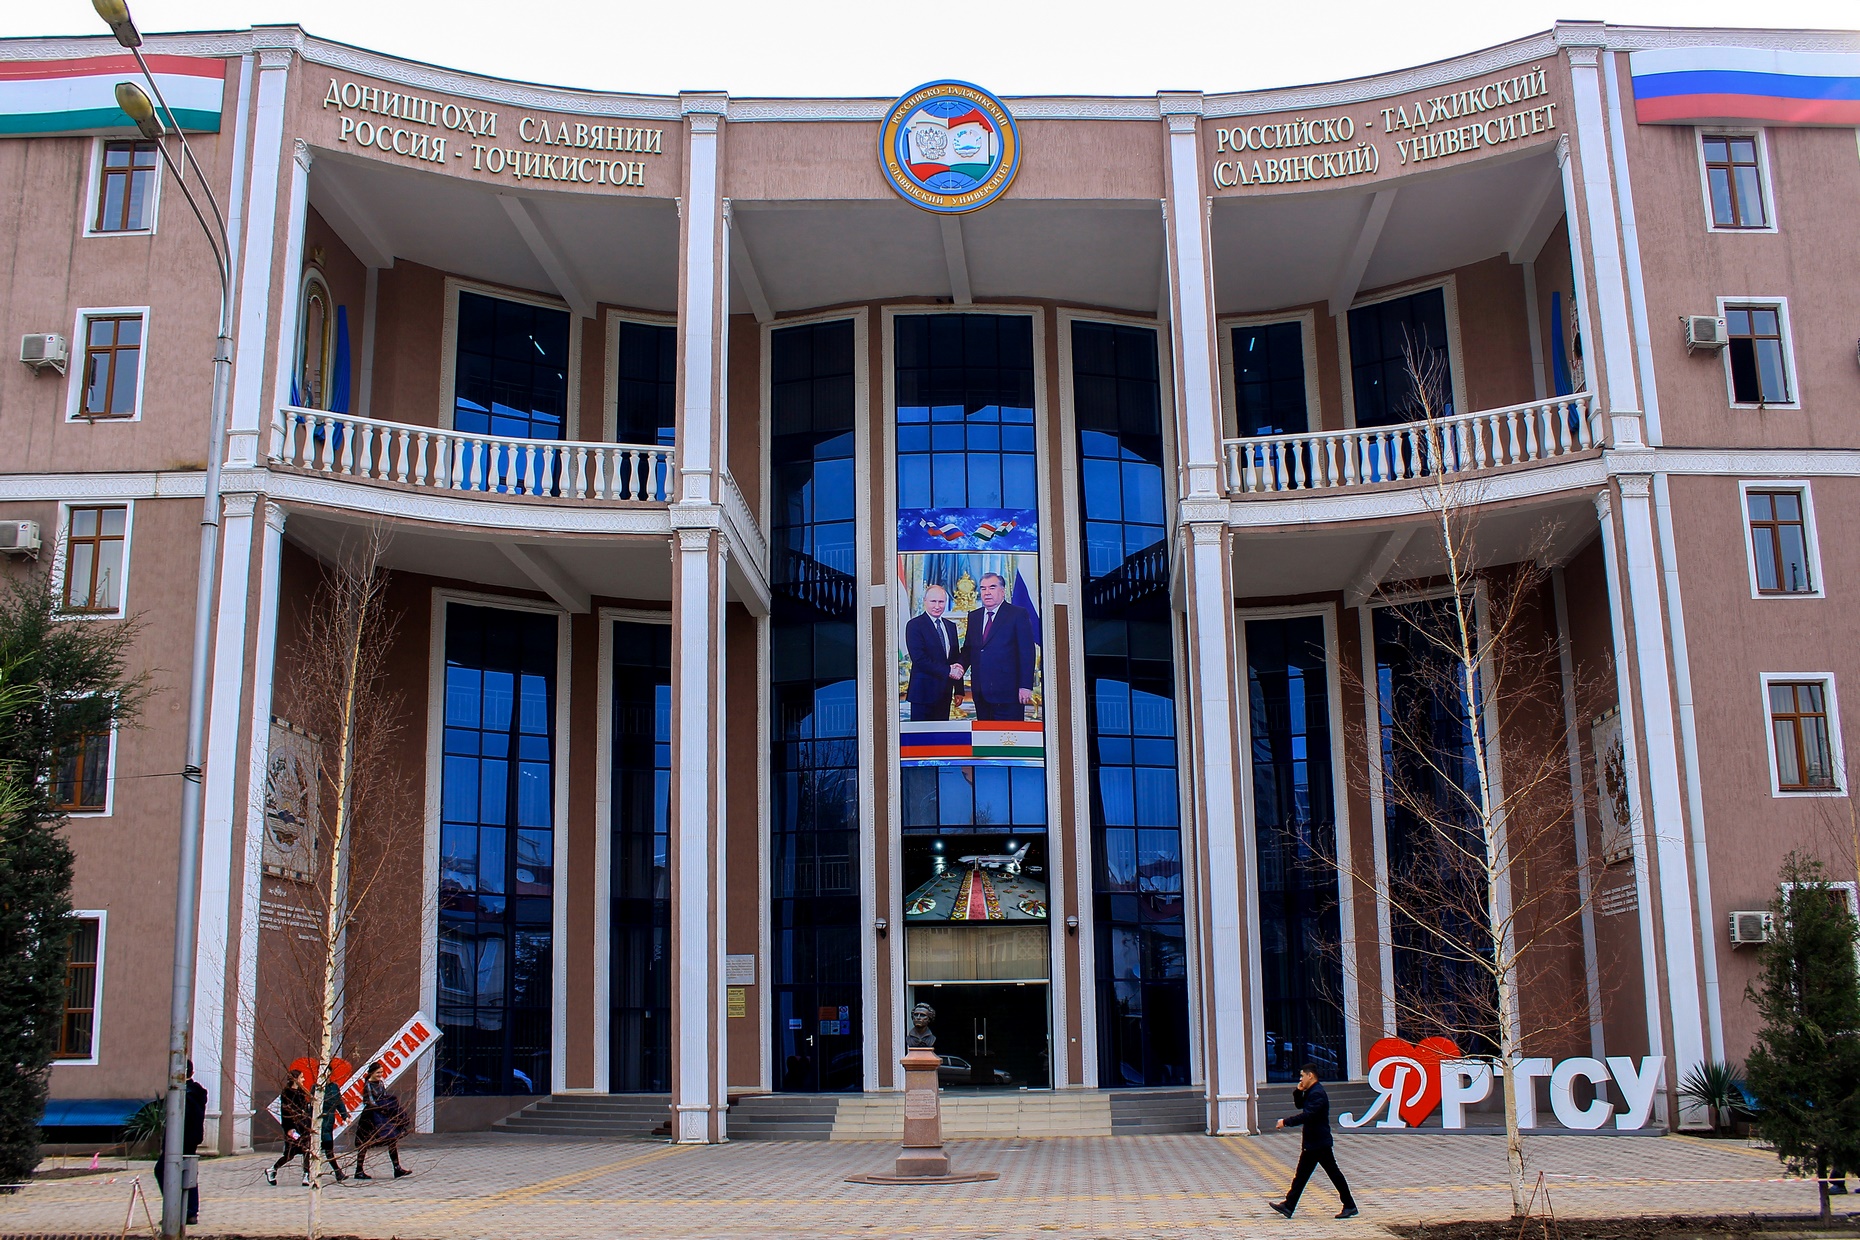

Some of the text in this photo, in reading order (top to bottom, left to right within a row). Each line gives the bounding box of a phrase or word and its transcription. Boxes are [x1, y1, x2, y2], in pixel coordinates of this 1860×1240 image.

[892, 87, 940, 125] РОССИЙСКО
[947, 86, 1009, 127] ТАДЖИКСКИЙ
[1216, 116, 1355, 153] РОССИЙСКО
[1380, 65, 1549, 135] ТАДЖИКСКИЙ
[339, 116, 447, 164] РОССИЯ
[519, 117, 663, 154] СЛАВЯНИИ
[1212, 103, 1557, 190] (СЛАВЯНСКИЙ) УНИВЕРСИТЕТ
[889, 161, 1010, 205] СЛАВЯНСКИЙ УНИВЕРСИТЕТ
[1338, 1055, 1667, 1130] Я РТСУ
